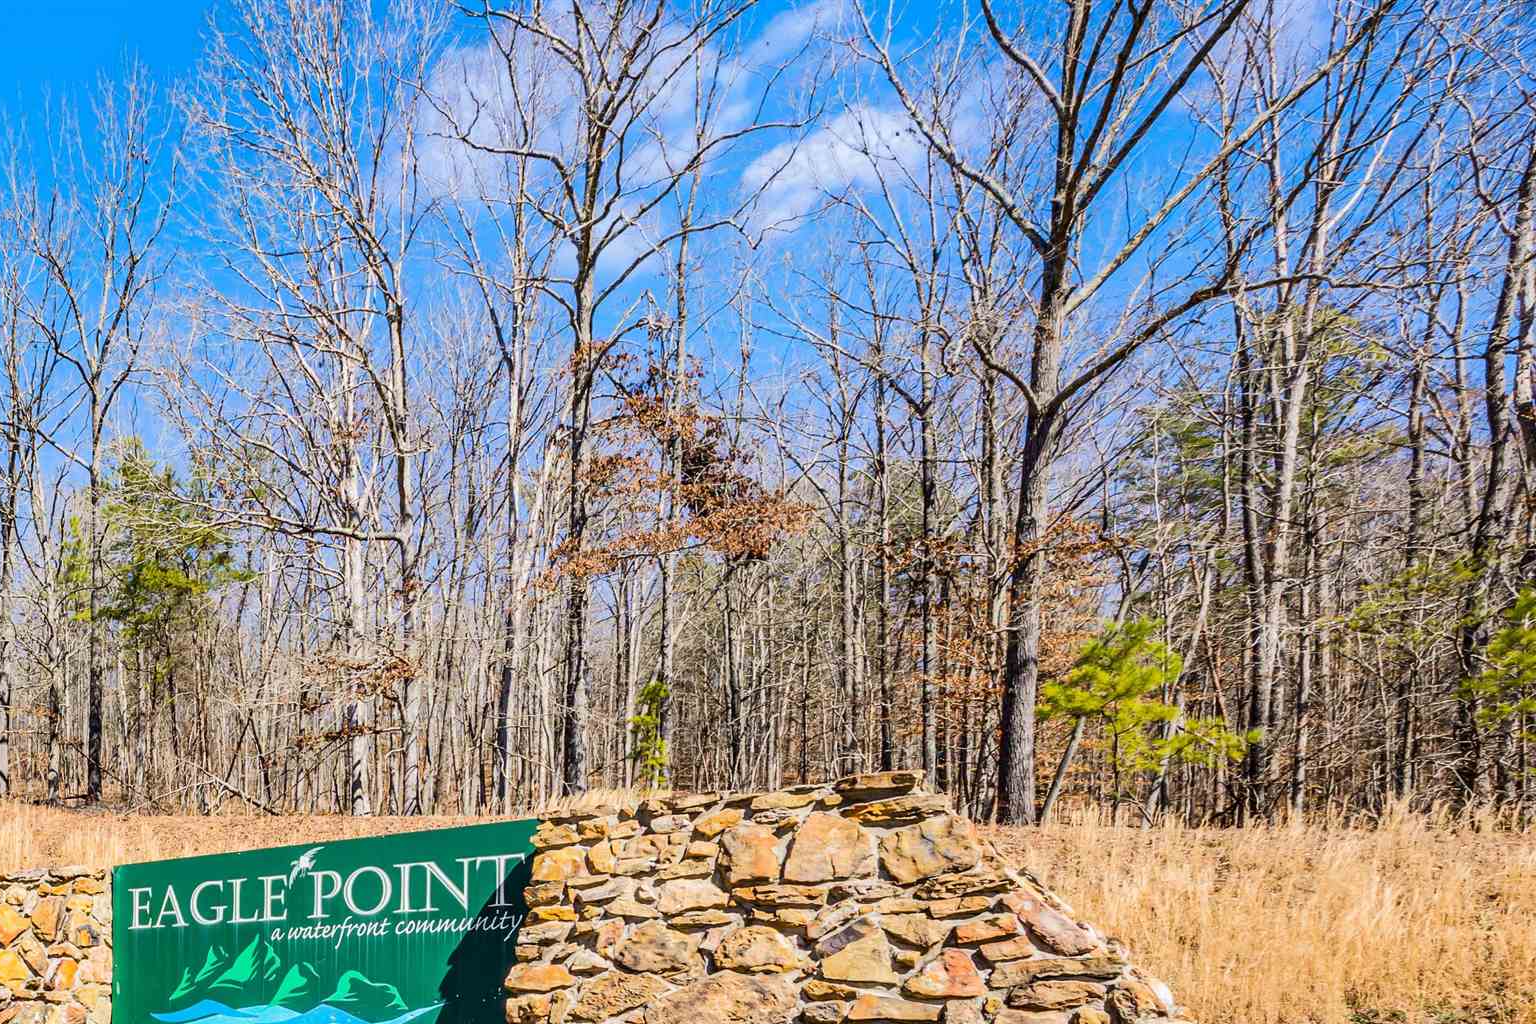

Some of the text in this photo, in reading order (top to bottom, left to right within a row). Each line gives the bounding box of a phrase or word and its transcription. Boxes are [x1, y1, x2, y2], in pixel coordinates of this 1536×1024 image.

[127, 853, 526, 930] EAGLE POINT
[270, 909, 523, 950] a waterfront community
